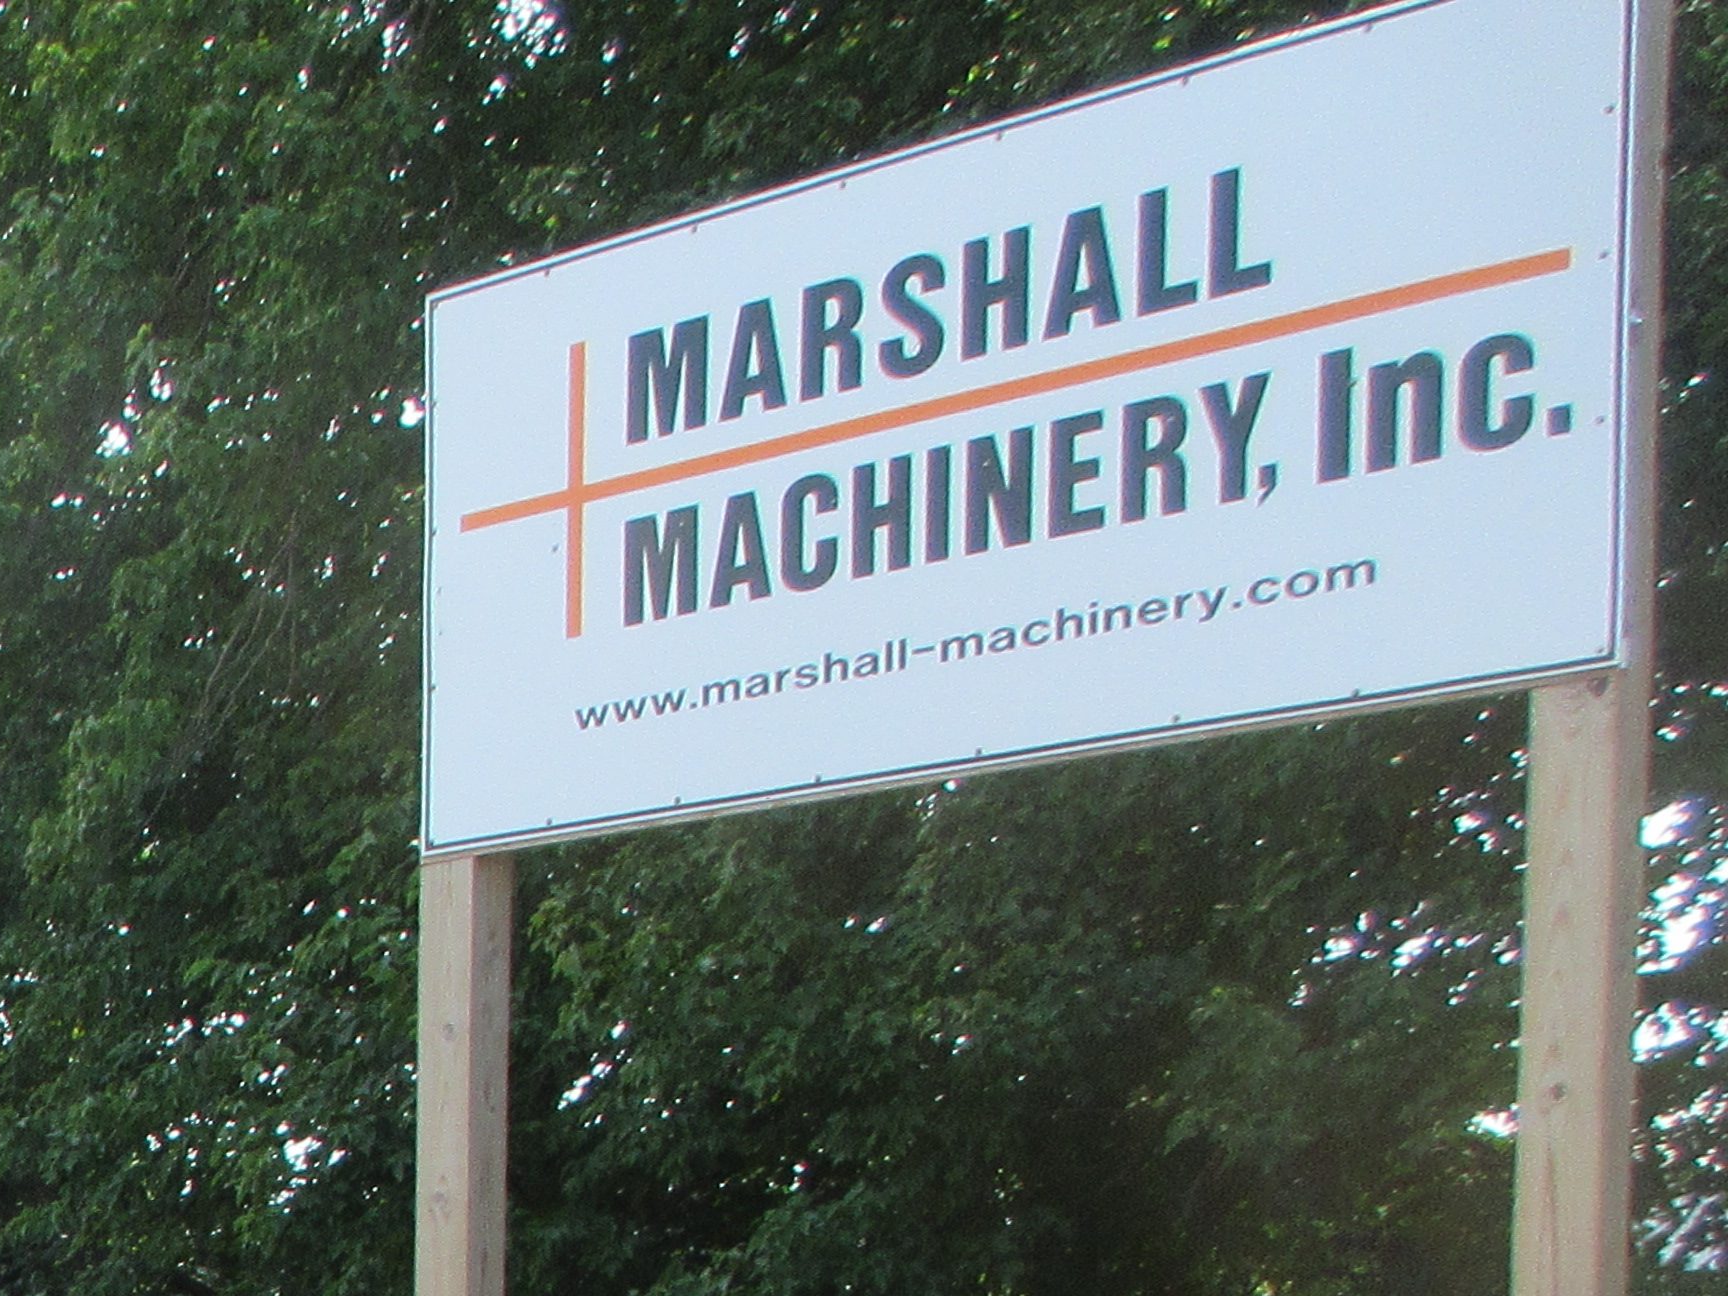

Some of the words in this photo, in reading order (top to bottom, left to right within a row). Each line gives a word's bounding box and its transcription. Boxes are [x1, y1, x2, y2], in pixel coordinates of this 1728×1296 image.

[625, 167, 1272, 445] MARSHALL
[621, 371, 1279, 628] MACHINERY,
[1315, 331, 1573, 484] Inc.
[574, 555, 1378, 731] www.marshall-machinery.com
